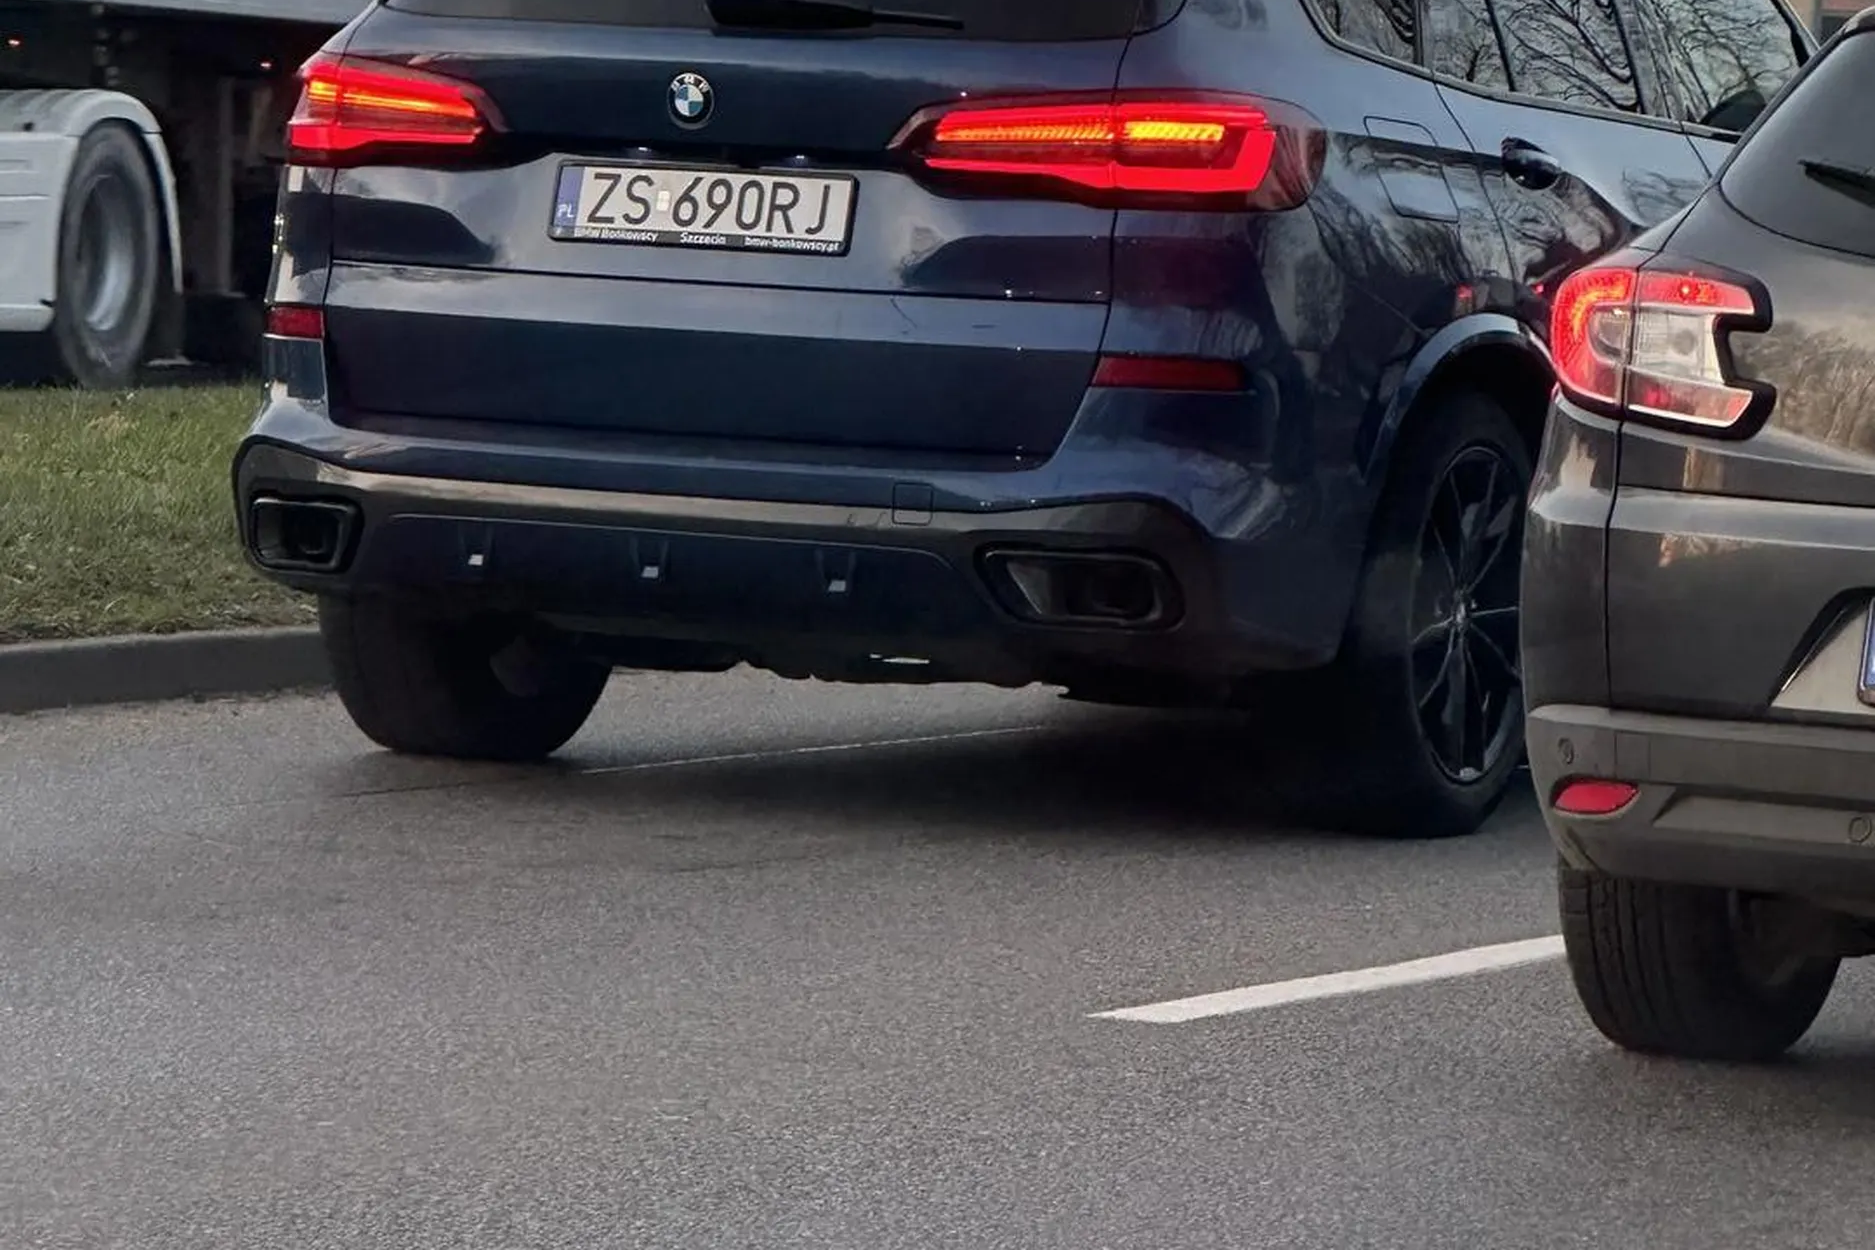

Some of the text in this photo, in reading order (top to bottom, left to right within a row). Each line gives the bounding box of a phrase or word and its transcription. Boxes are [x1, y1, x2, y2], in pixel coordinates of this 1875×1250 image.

[670, 74, 709, 92] BMW
[556, 204, 575, 218] PL
[587, 172, 831, 235] ZS 690RJ
